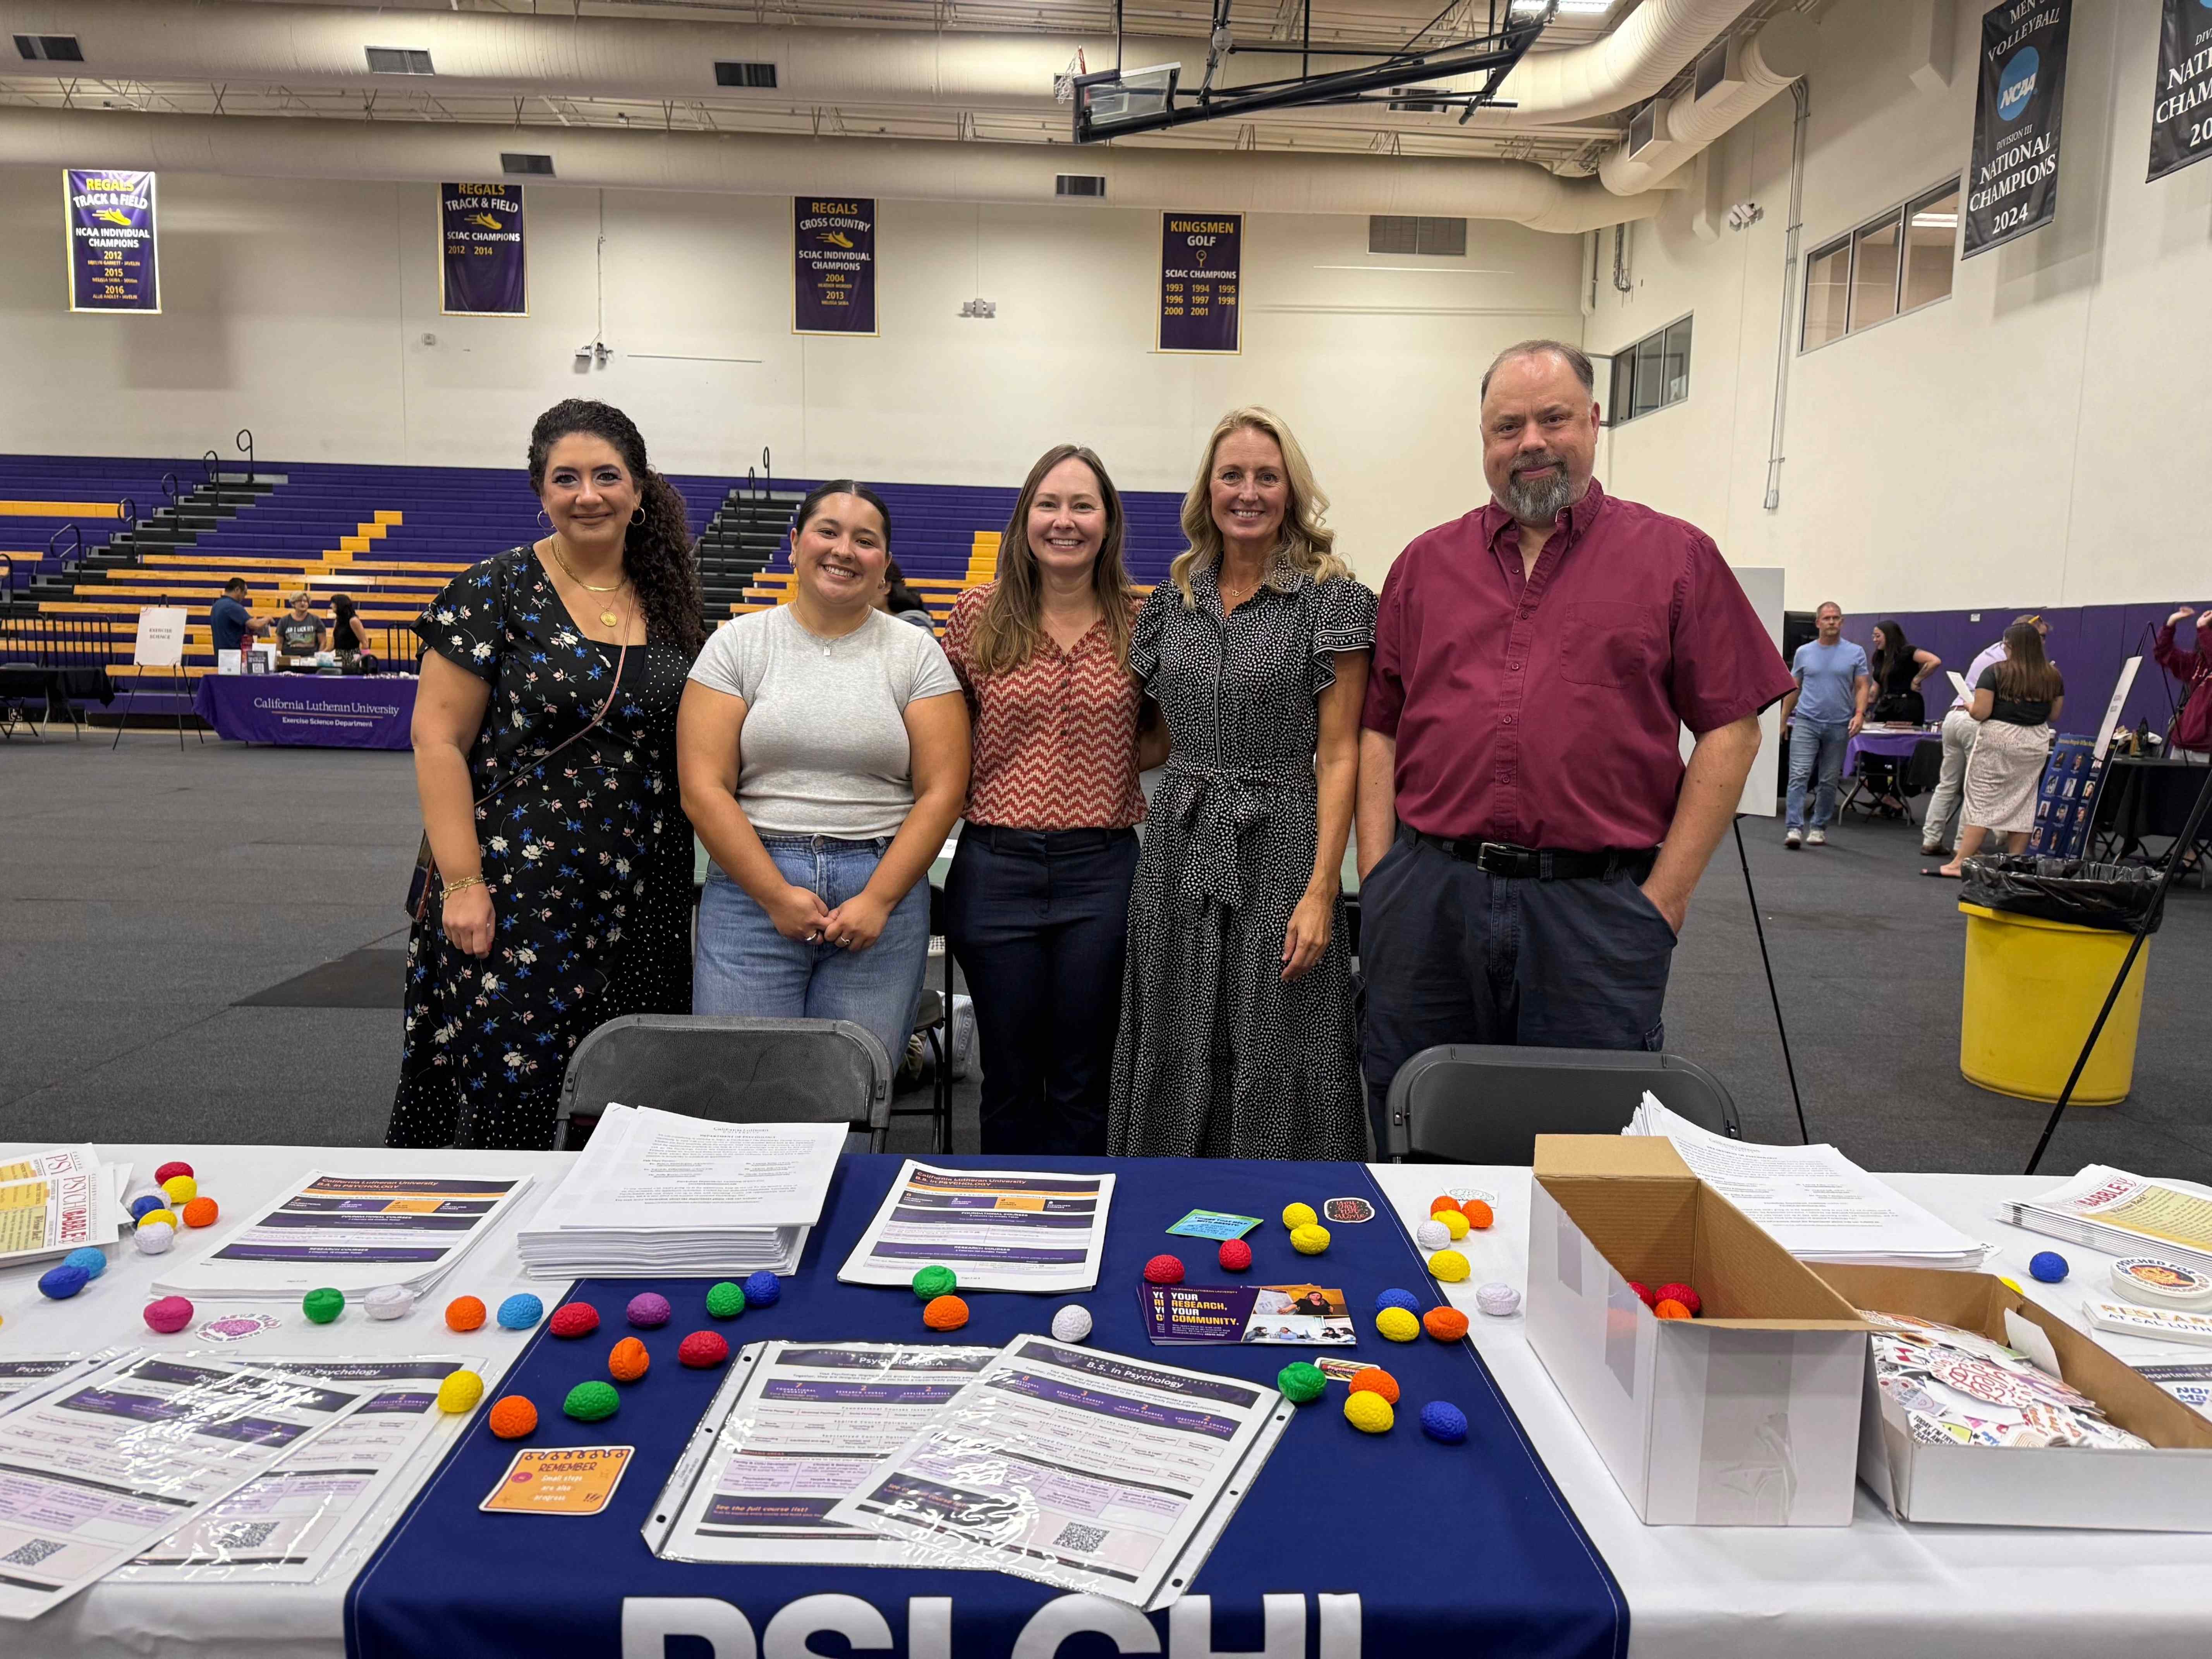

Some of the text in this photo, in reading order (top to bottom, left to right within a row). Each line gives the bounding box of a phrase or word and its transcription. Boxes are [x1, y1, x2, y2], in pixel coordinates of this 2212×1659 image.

[2009, 0, 2045, 24] MEN
[1988, 8, 2059, 62] VOLLEYBALL
[2195, 28, 2212, 46] DIV
[2000, 73, 2036, 109] NCAA
[1996, 124, 2033, 151] DIVISION III
[1979, 132, 2051, 184] NATIONAL
[86, 179, 134, 191] REGALS
[1970, 154, 2056, 212] CHAMPIONS
[458, 183, 505, 196] REGALS
[73, 193, 148, 209] TRACK & FIELD
[445, 198, 519, 213] TRACK & FIELD
[812, 203, 858, 215] REGALS
[1992, 202, 2028, 234] 2024
[800, 218, 871, 232] CROSS COUNTRY
[1170, 221, 1233, 234] KINGSMEN
[76, 228, 151, 238] NCAA INDIVIDUAL
[447, 232, 520, 242] SCIAC CHAMPIONS
[89, 239, 139, 248] CHAMPIONS
[1187, 235, 1216, 247] GOLF
[104, 251, 122, 259] 2012
[448, 246, 493, 255] 2012 2014
[799, 251, 871, 261] SCIAC INDIVIDUAL
[812, 261, 860, 271] CHAMPIONS
[105, 268, 123, 277] 2015
[1165, 270, 1236, 279] SCIAC CHAMPIONS
[825, 274, 845, 282] 2004
[105, 286, 124, 294] 2016
[1166, 284, 1235, 293] 1993 1994 1995
[826, 291, 844, 300] 2013
[1166, 295, 1183, 304] 1996
[1218, 297, 1235, 305] 1998
[1164, 307, 1208, 316] 2000 2001
[254, 697, 399, 717] California Lutheran University
[310, 718, 333, 726] Science
[335, 720, 373, 728] Department
[917, 1172, 952, 1181] California
[1171, 1292, 1198, 1301] YOUR
[1172, 1300, 1227, 1310] RESEARCH.
[1172, 1307, 1199, 1316] YOUR
[1172, 1315, 1239, 1325] COMMUNITY.
[2132, 1317, 2164, 1326] CAL
[314, 1368, 381, 1376] Psychology
[1086, 1362, 1106, 1372] B.S.
[1124, 1370, 1184, 1388] Psychology
[1923, 1428, 1932, 1436] AN
[538, 1462, 597, 1472] REMEMBER
